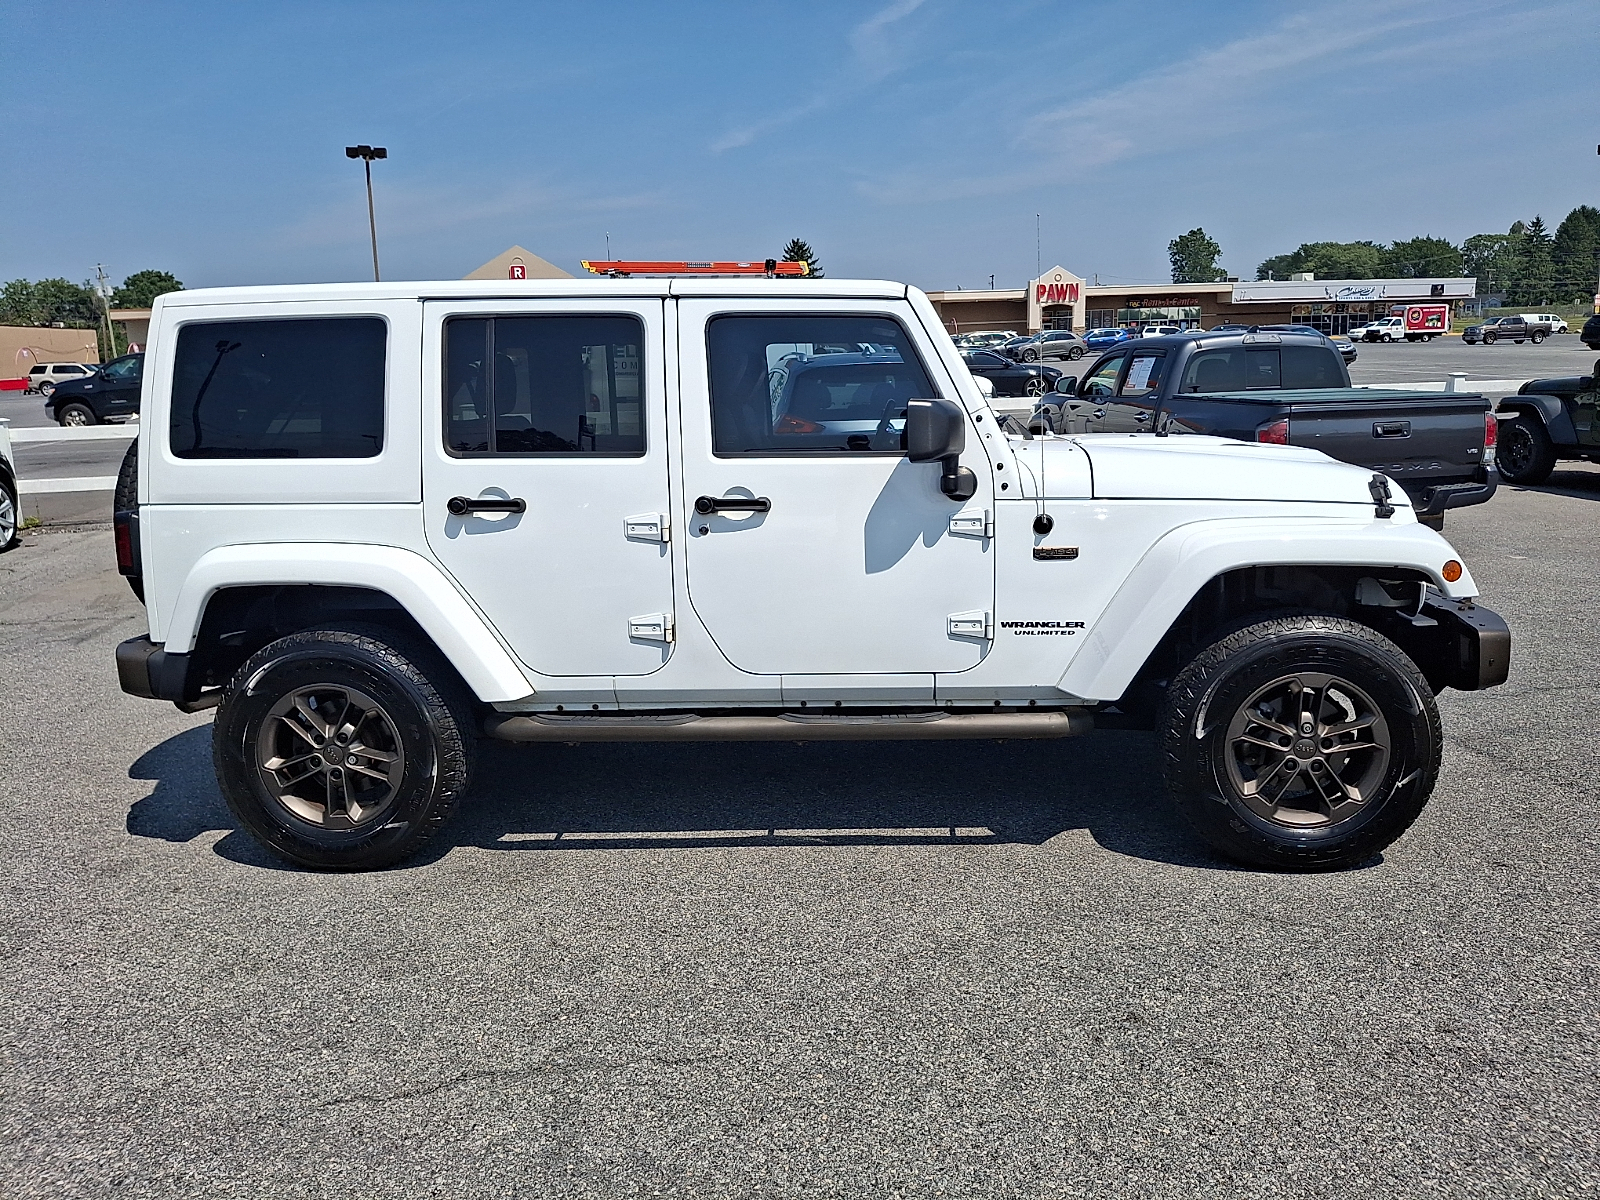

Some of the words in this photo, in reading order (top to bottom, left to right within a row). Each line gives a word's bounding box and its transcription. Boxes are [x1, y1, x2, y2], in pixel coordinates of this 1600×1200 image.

[514, 267, 523, 279] R
[1036, 283, 1079, 304] PAWN
[1000, 621, 1086, 629] WRANGLER
